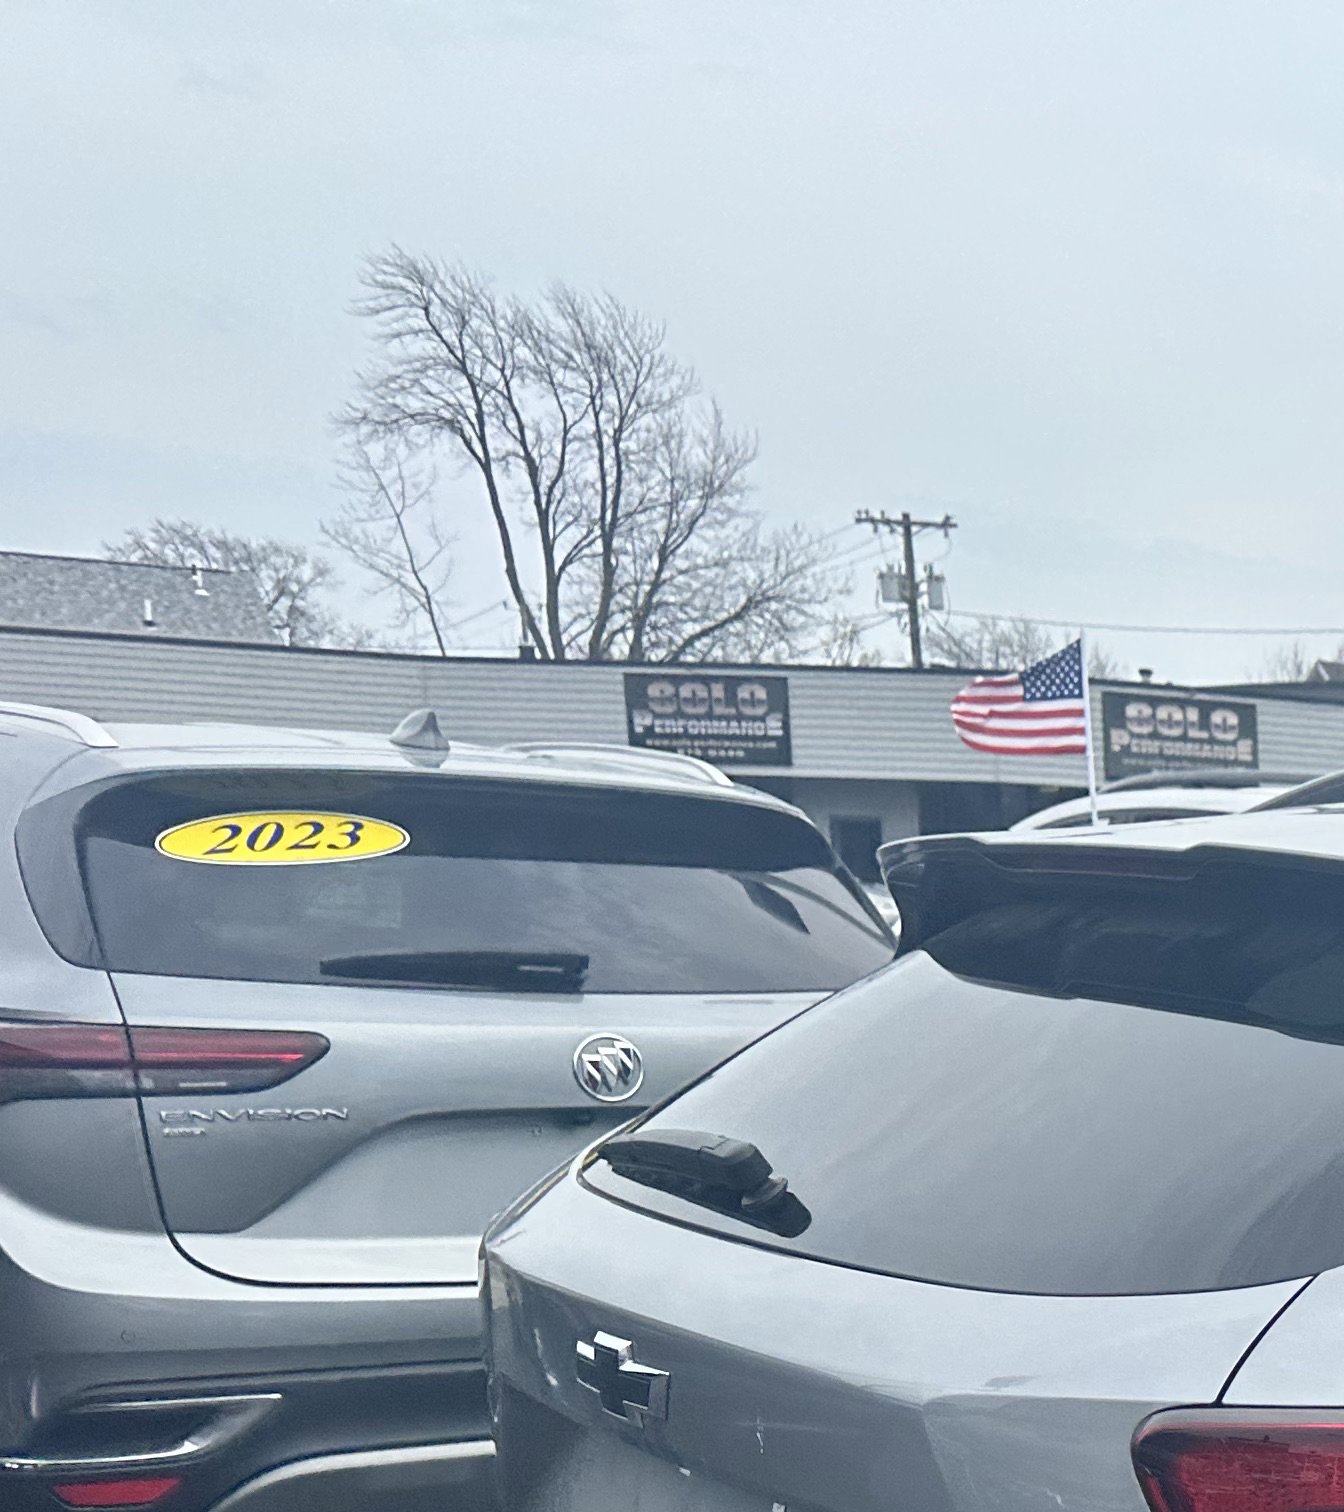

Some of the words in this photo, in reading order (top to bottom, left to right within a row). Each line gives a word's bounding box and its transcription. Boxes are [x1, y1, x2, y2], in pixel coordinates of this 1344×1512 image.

[647, 681, 768, 717] SOLO
[1125, 702, 1239, 741] SOLO
[202, 820, 364, 856] 2023
[160, 1107, 348, 1123] ENVISION
